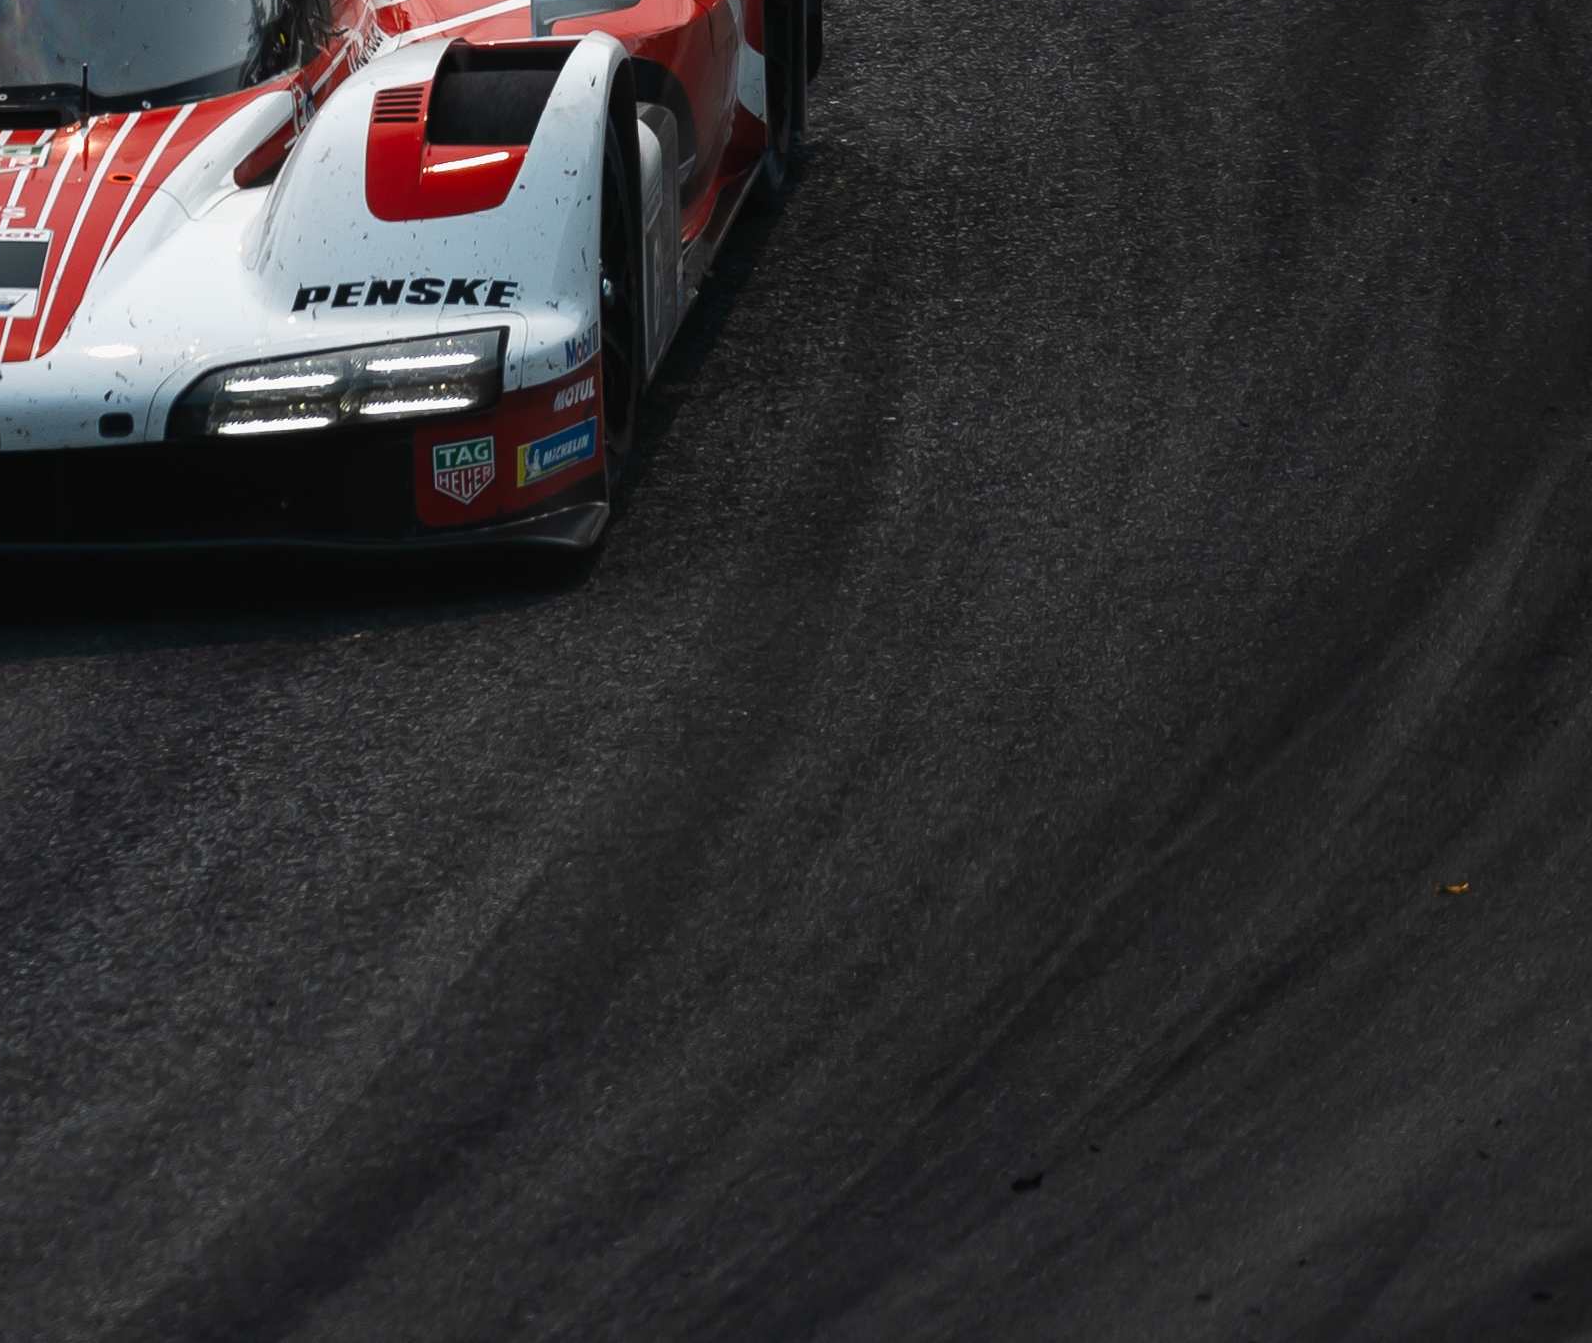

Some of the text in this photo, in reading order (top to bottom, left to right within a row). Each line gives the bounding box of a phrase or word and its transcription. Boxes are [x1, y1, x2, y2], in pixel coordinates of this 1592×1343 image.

[292, 276, 518, 311] PENSKE
[553, 376, 595, 412] MOTUL
[439, 442, 489, 467] TAG
[542, 435, 590, 466] MICHELIN
[437, 465, 492, 497] HEUER
